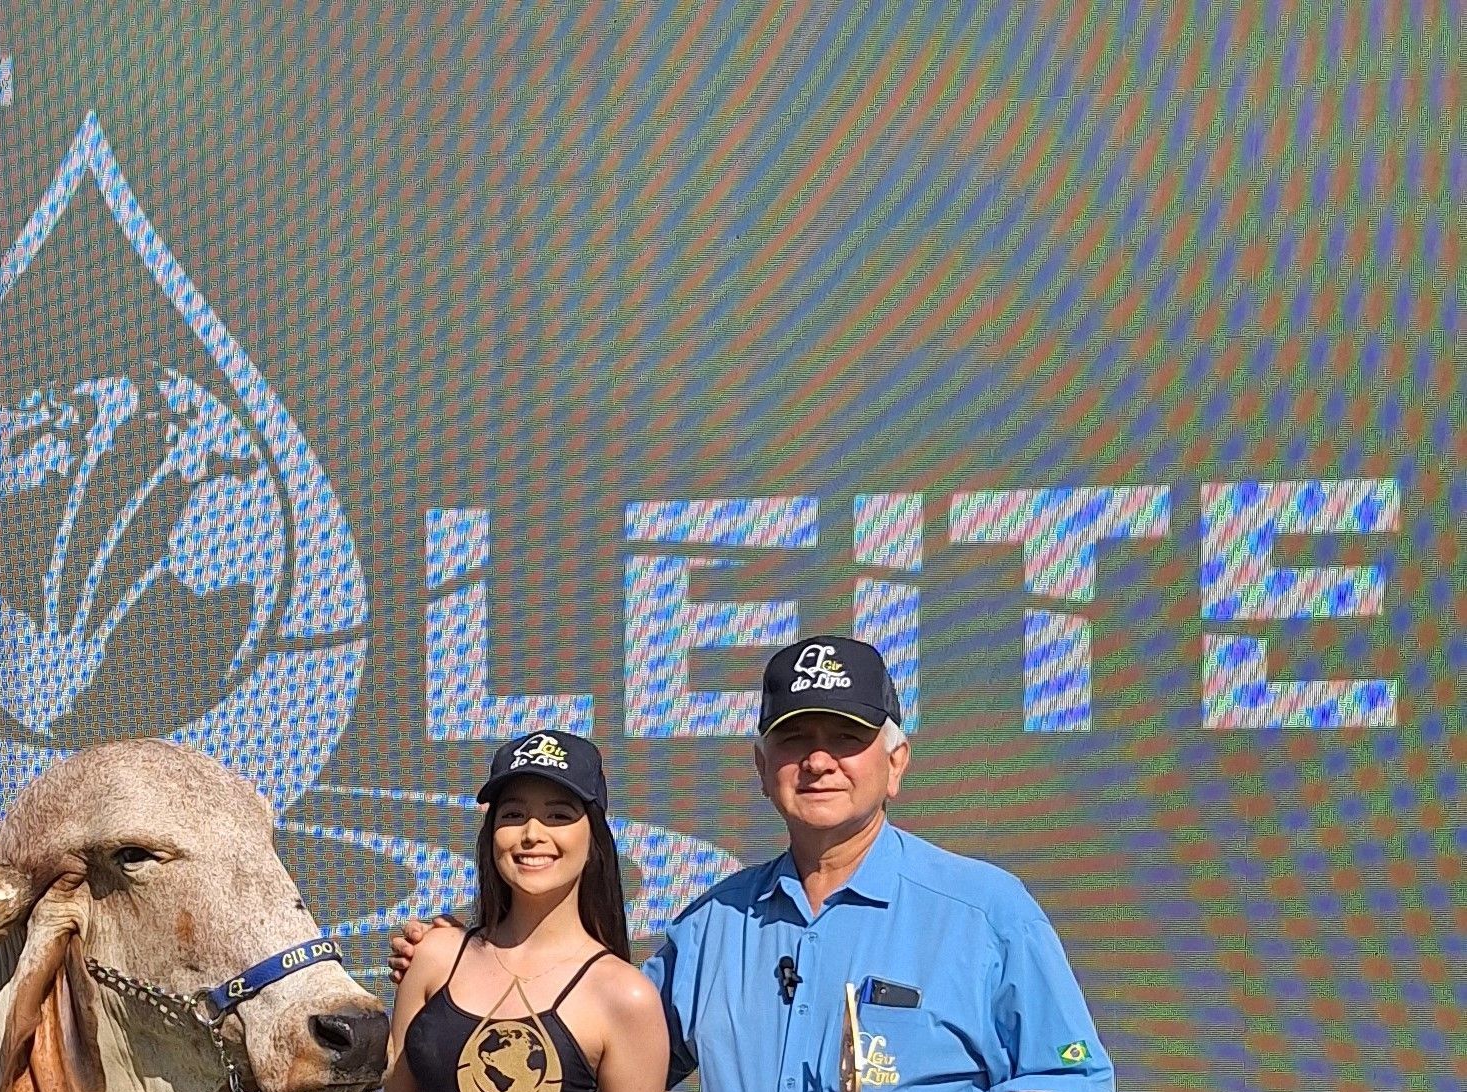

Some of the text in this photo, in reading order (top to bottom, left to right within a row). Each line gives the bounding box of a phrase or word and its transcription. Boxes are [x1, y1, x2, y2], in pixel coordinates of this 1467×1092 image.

[425, 478, 1401, 741] LEITE
[791, 675, 812, 692] do
[510, 756, 528, 770] do
[282, 947, 310, 969] GIR
[311, 942, 333, 958] DO
